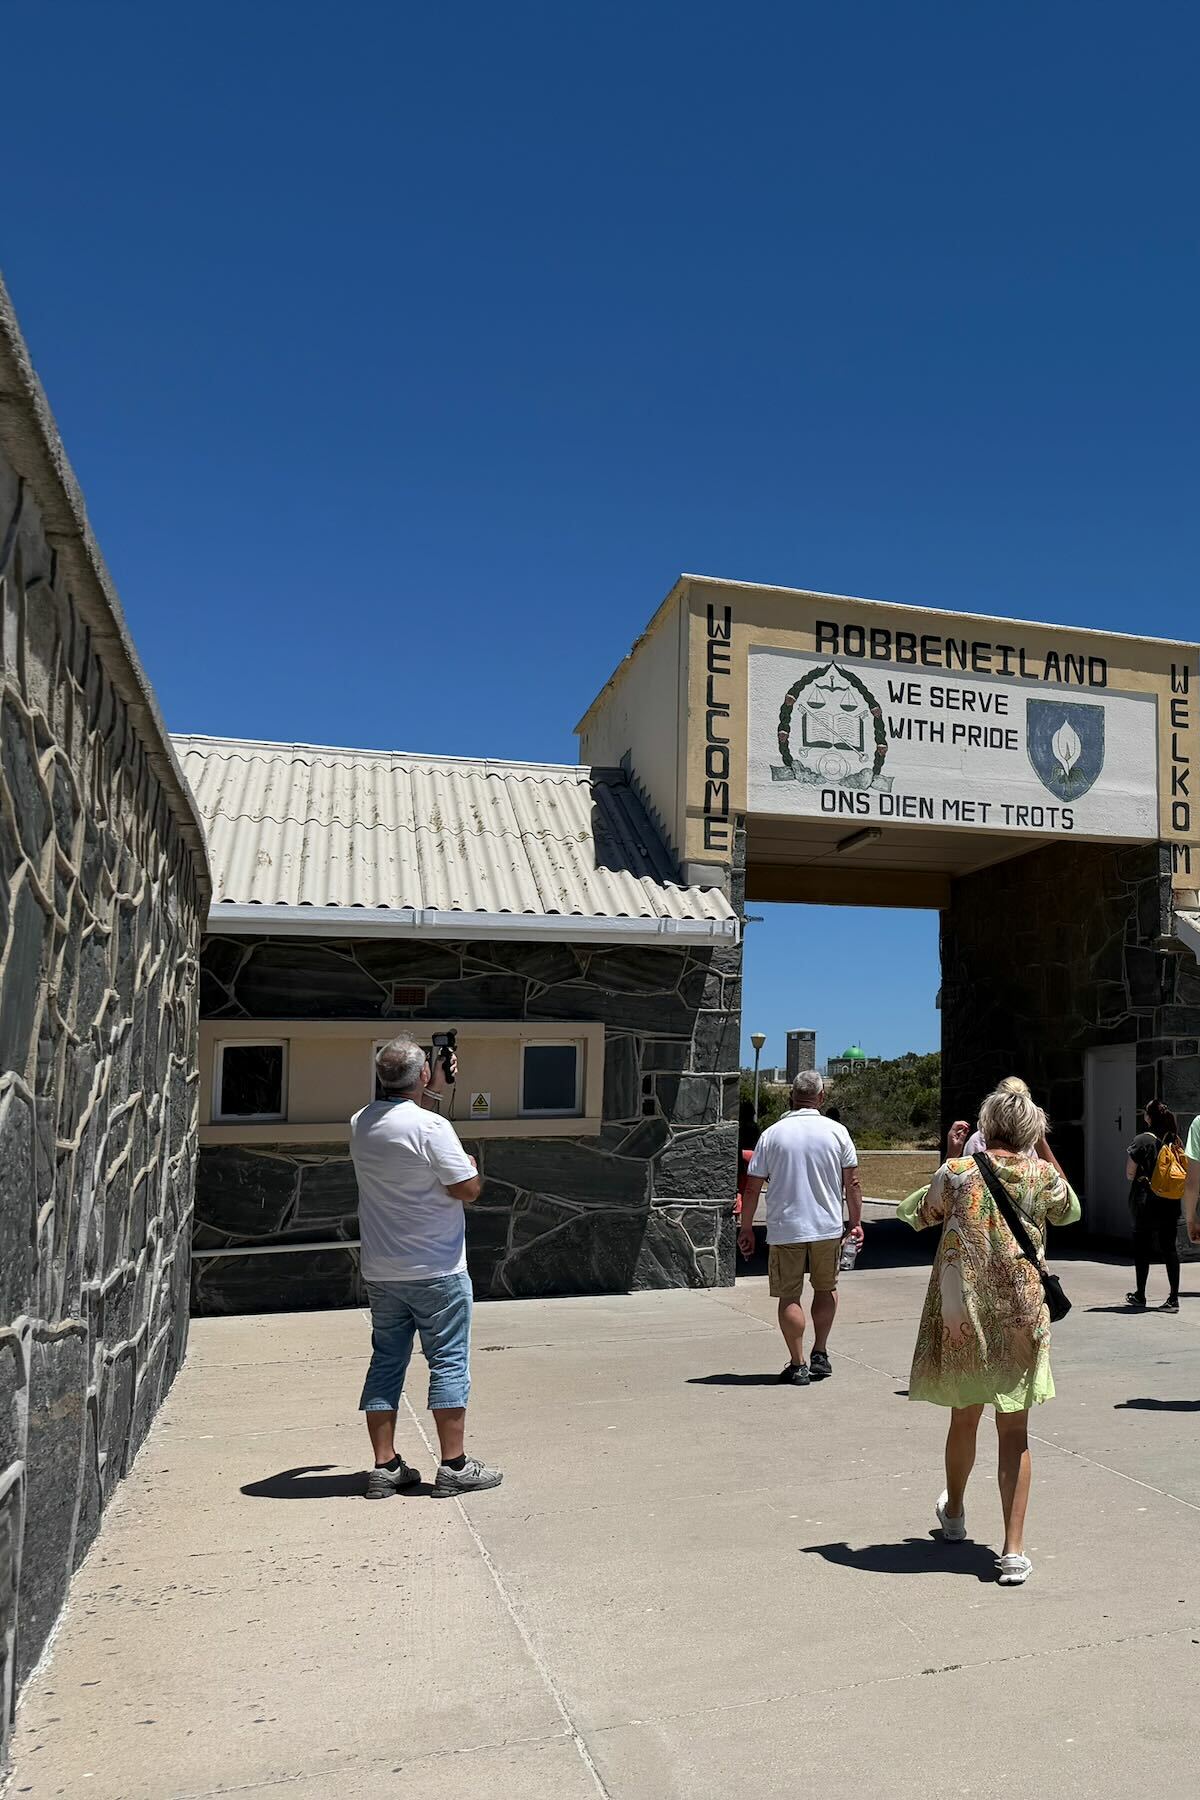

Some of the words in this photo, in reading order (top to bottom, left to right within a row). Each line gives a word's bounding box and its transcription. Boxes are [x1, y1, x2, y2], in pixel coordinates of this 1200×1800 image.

[815, 620, 1108, 688] ROBBENEILAND
[887, 680, 922, 706] WE
[930, 686, 1009, 715] SERVE
[703, 603, 732, 851] WELCOME
[888, 716, 945, 743] WITH
[952, 723, 1018, 750] PRIDE
[1170, 663, 1191, 875] WELKOM
[821, 789, 870, 815] ONS
[879, 793, 934, 819] DIEN
[942, 799, 992, 823] MET
[1000, 803, 1074, 830] TROTS
